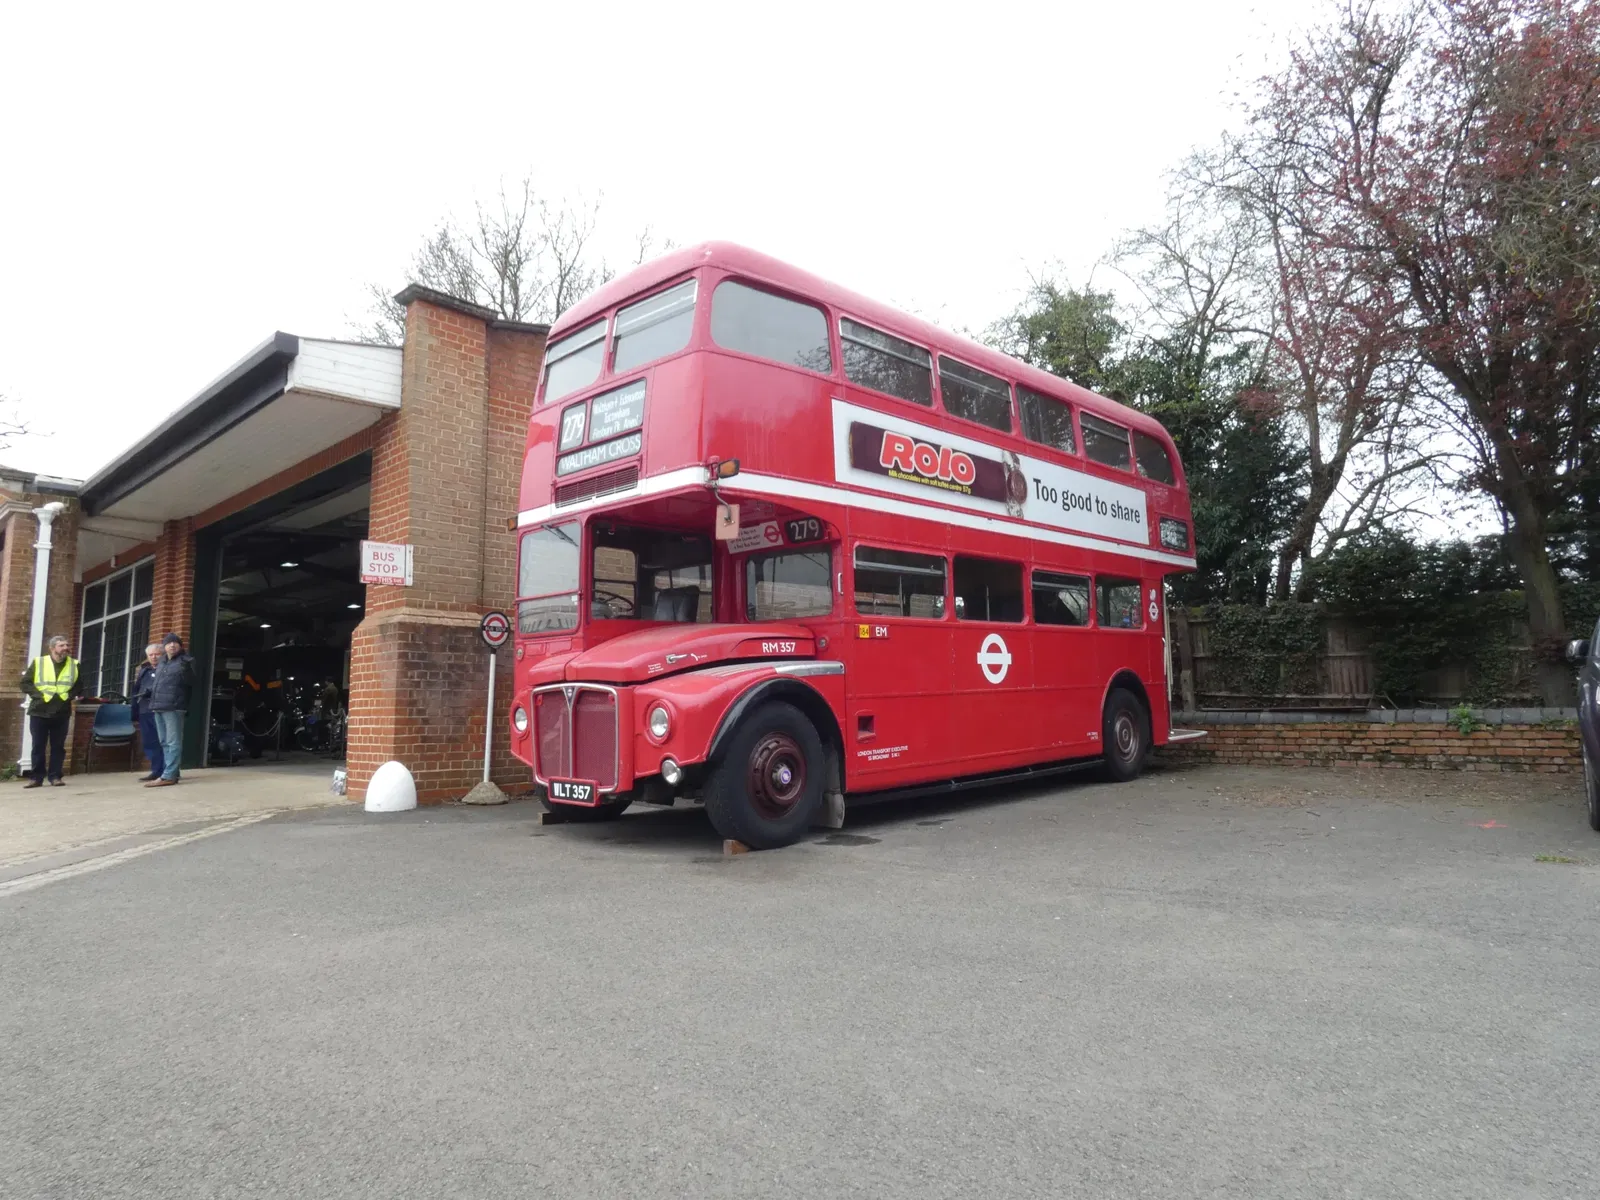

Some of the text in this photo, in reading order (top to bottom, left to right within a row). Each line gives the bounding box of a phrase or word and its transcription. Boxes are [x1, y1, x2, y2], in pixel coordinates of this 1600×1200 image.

[562, 412, 585, 443] 279
[561, 435, 641, 470] WALTHAM CROSS
[880, 430, 976, 485] Rolo
[888, 469, 899, 477] Milk
[938, 480, 949, 489] toffee
[1033, 477, 1141, 524] Too good to share
[790, 519, 819, 540] 279
[373, 551, 395, 562] BUS
[369, 562, 398, 574] STOP
[378, 576, 392, 584] THIS
[875, 626, 887, 637] EM
[762, 642, 796, 653] RM 357
[553, 782, 591, 800] WLT 357
